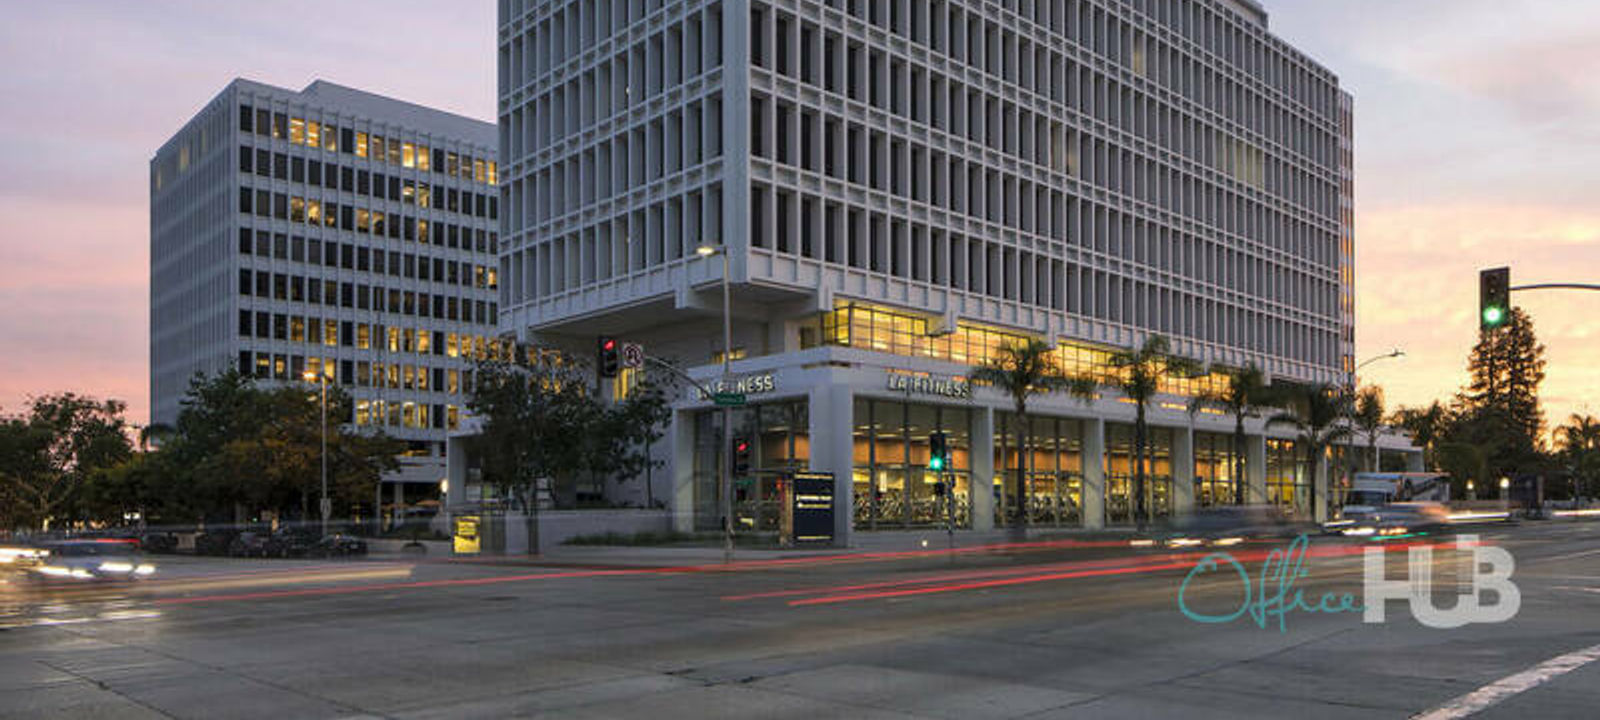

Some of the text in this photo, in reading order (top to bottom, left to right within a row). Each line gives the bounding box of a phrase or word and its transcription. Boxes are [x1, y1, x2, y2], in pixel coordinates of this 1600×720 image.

[717, 374, 774, 394] FNESS
[888, 375, 971, 398] LA FITNESS
